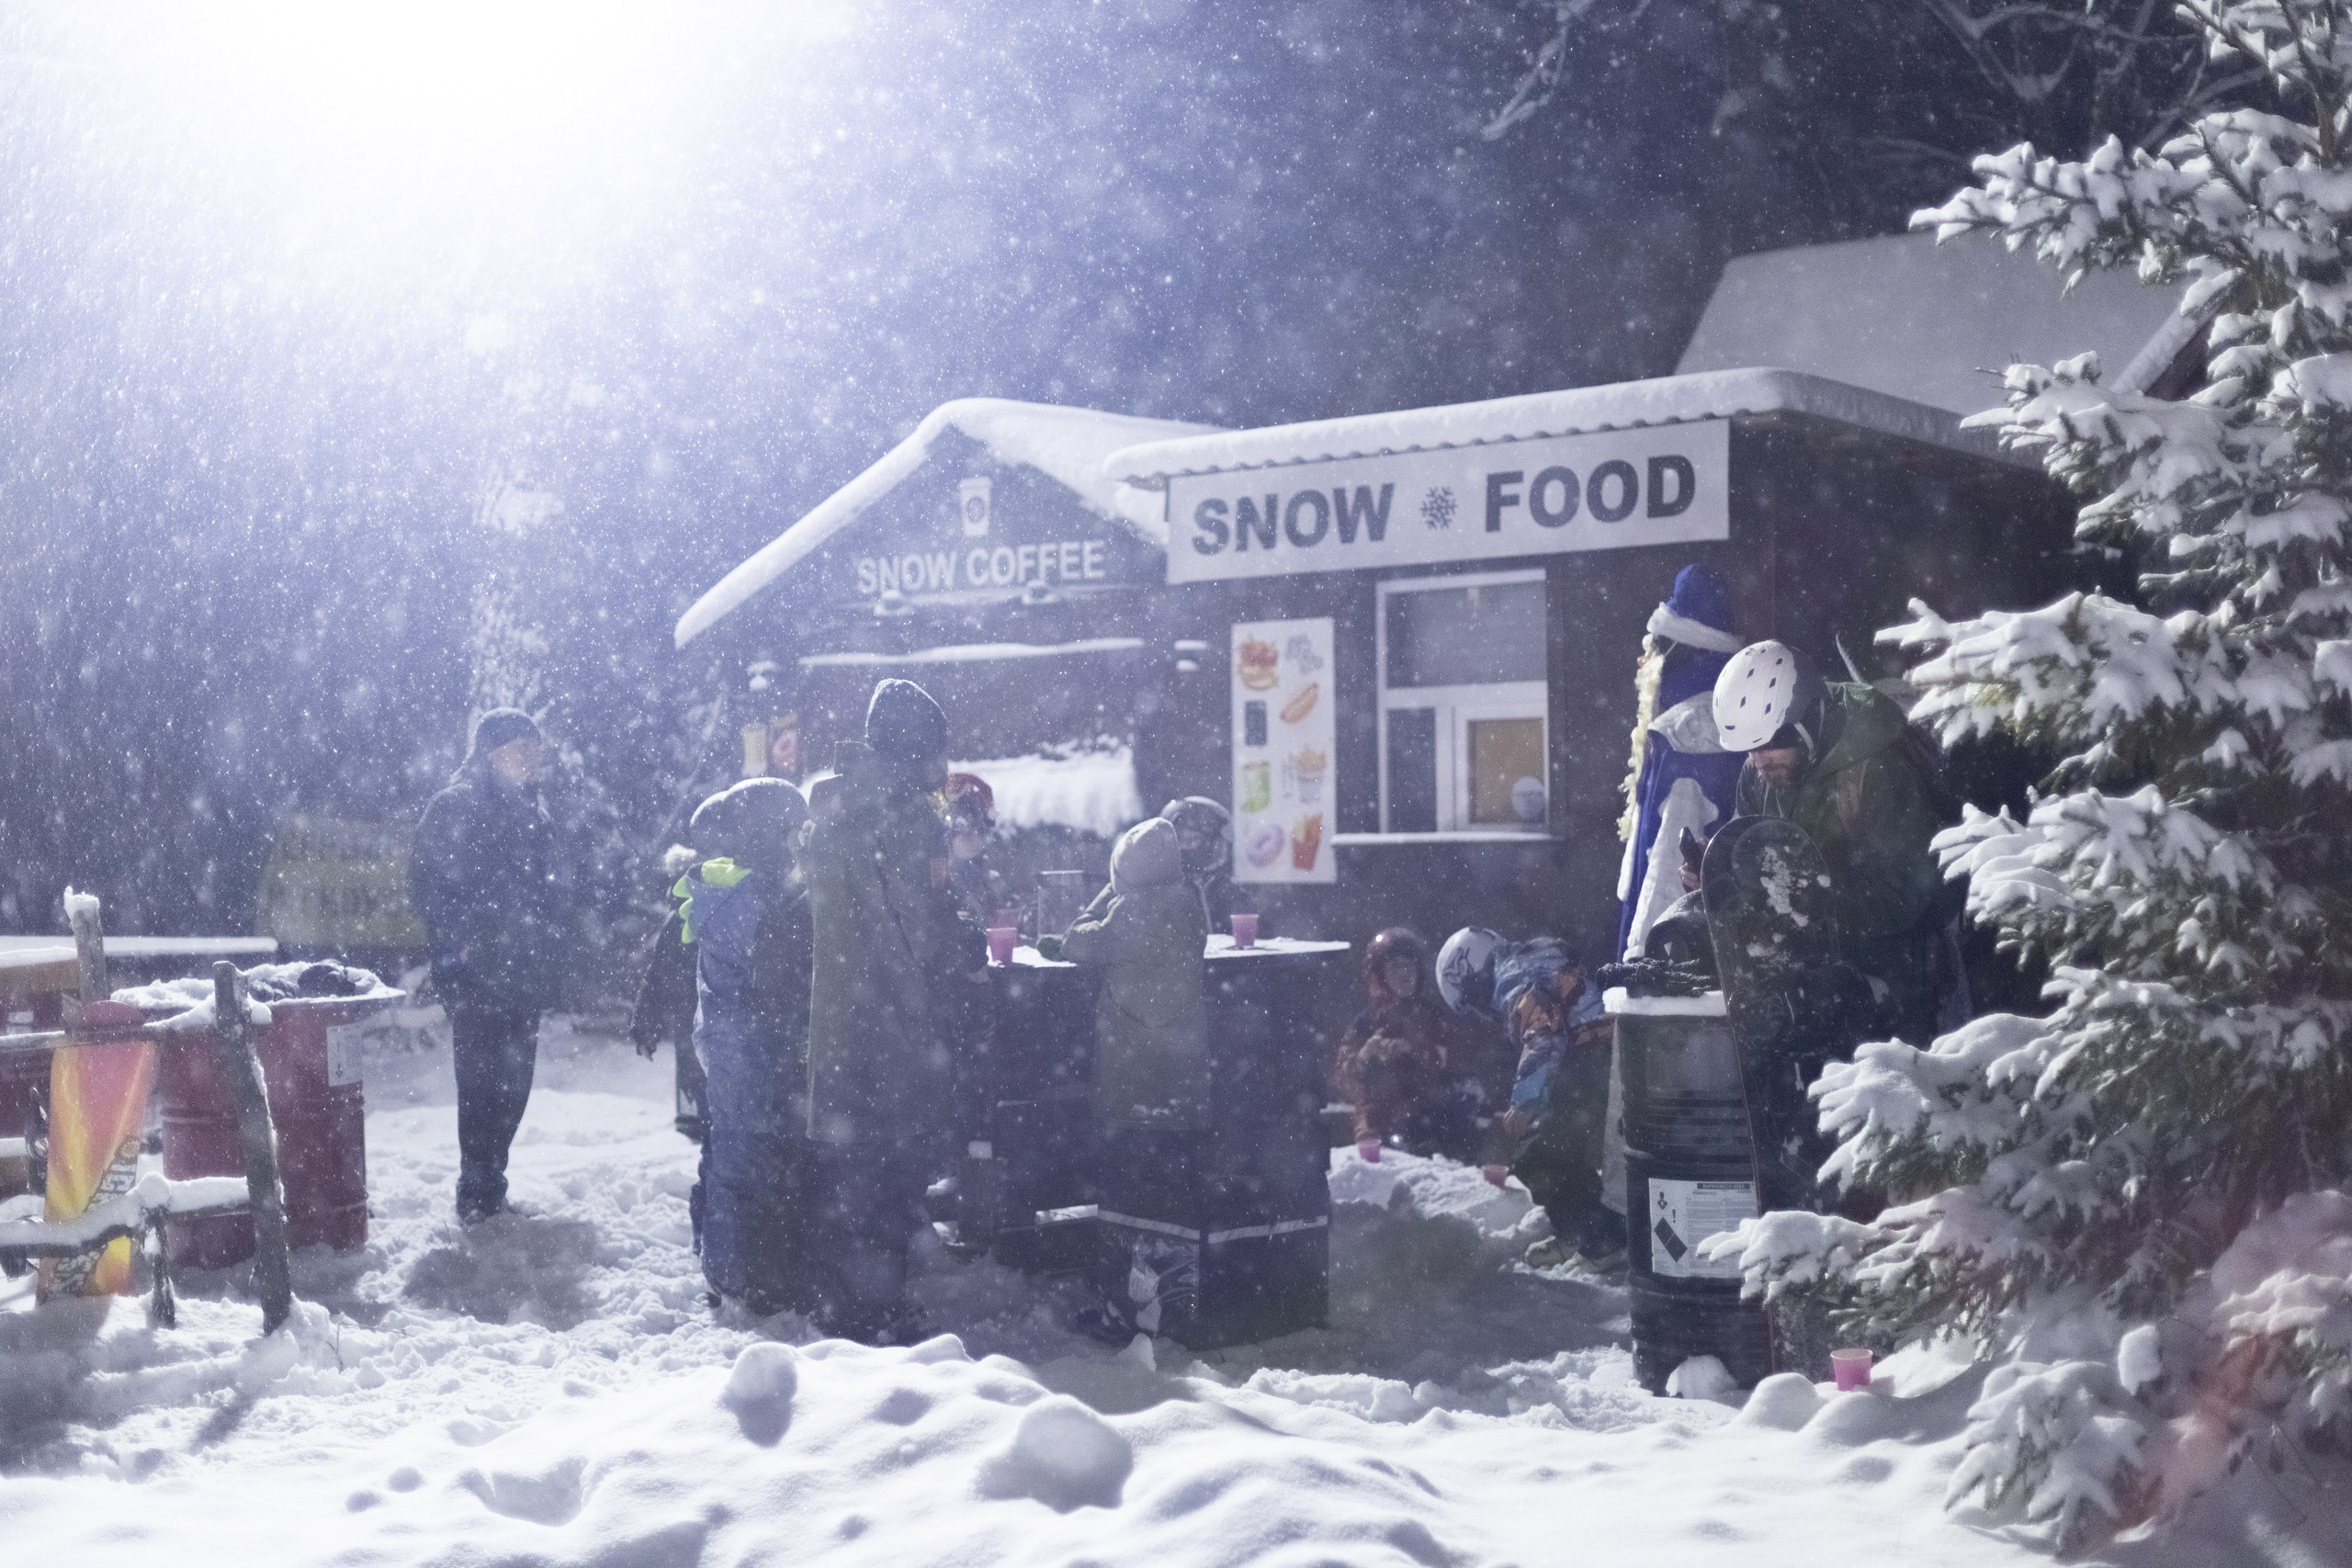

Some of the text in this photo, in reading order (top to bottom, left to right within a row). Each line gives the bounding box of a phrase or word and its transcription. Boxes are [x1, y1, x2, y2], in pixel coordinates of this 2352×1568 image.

[1191, 454, 1696, 557] SNOW FOOD
[856, 539, 1105, 594] SNOW COFFEE
